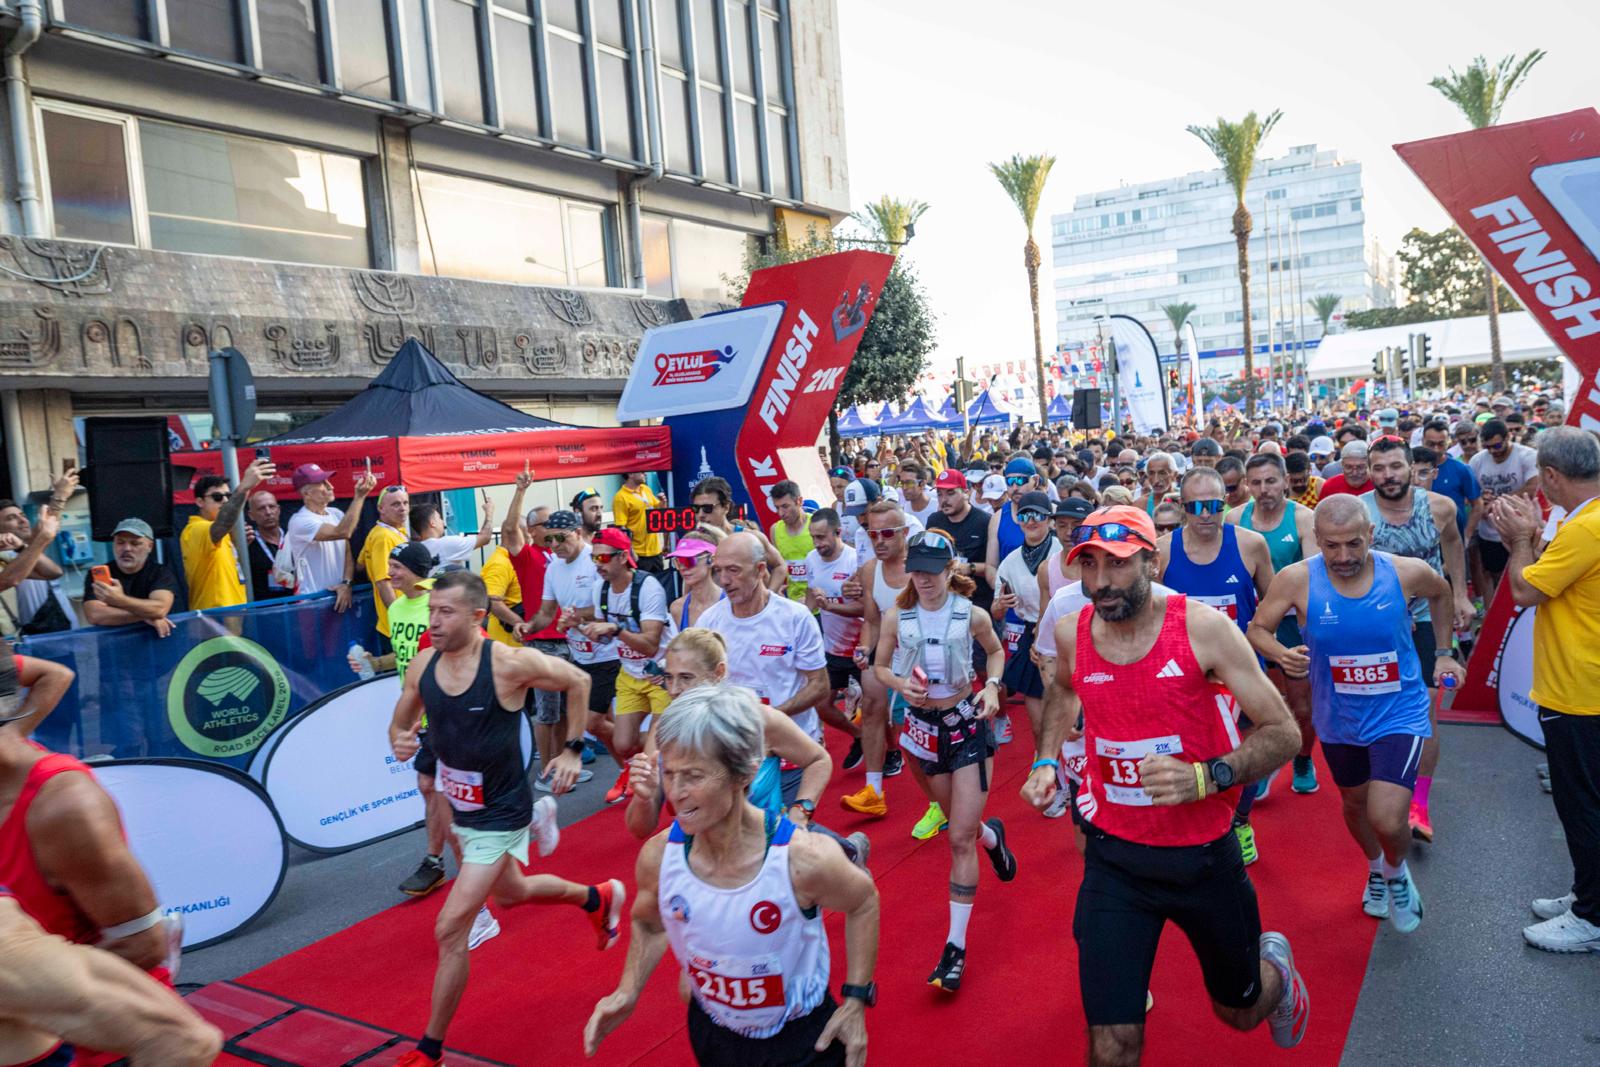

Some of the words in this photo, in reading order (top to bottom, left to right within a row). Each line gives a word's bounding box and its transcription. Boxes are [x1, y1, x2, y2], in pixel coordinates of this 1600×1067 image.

[1470, 195, 1600, 340] FINISH
[759, 309, 819, 434] FINISH
[803, 366, 845, 393] 21K
[460, 448, 497, 459] TIMING
[1342, 665, 1389, 682] 1865
[203, 713, 260, 731] ATHLETICS
[211, 705, 250, 719] WORLD
[213, 742, 245, 753] ROAD
[244, 726, 271, 747] RACE
[1109, 758, 1143, 785] 13
[320, 807, 358, 826] GENÇLİK
[358, 803, 371, 813] VE
[371, 796, 394, 809] SPOR
[394, 788, 419, 801] HİZME
[696, 970, 767, 1007] 2115
